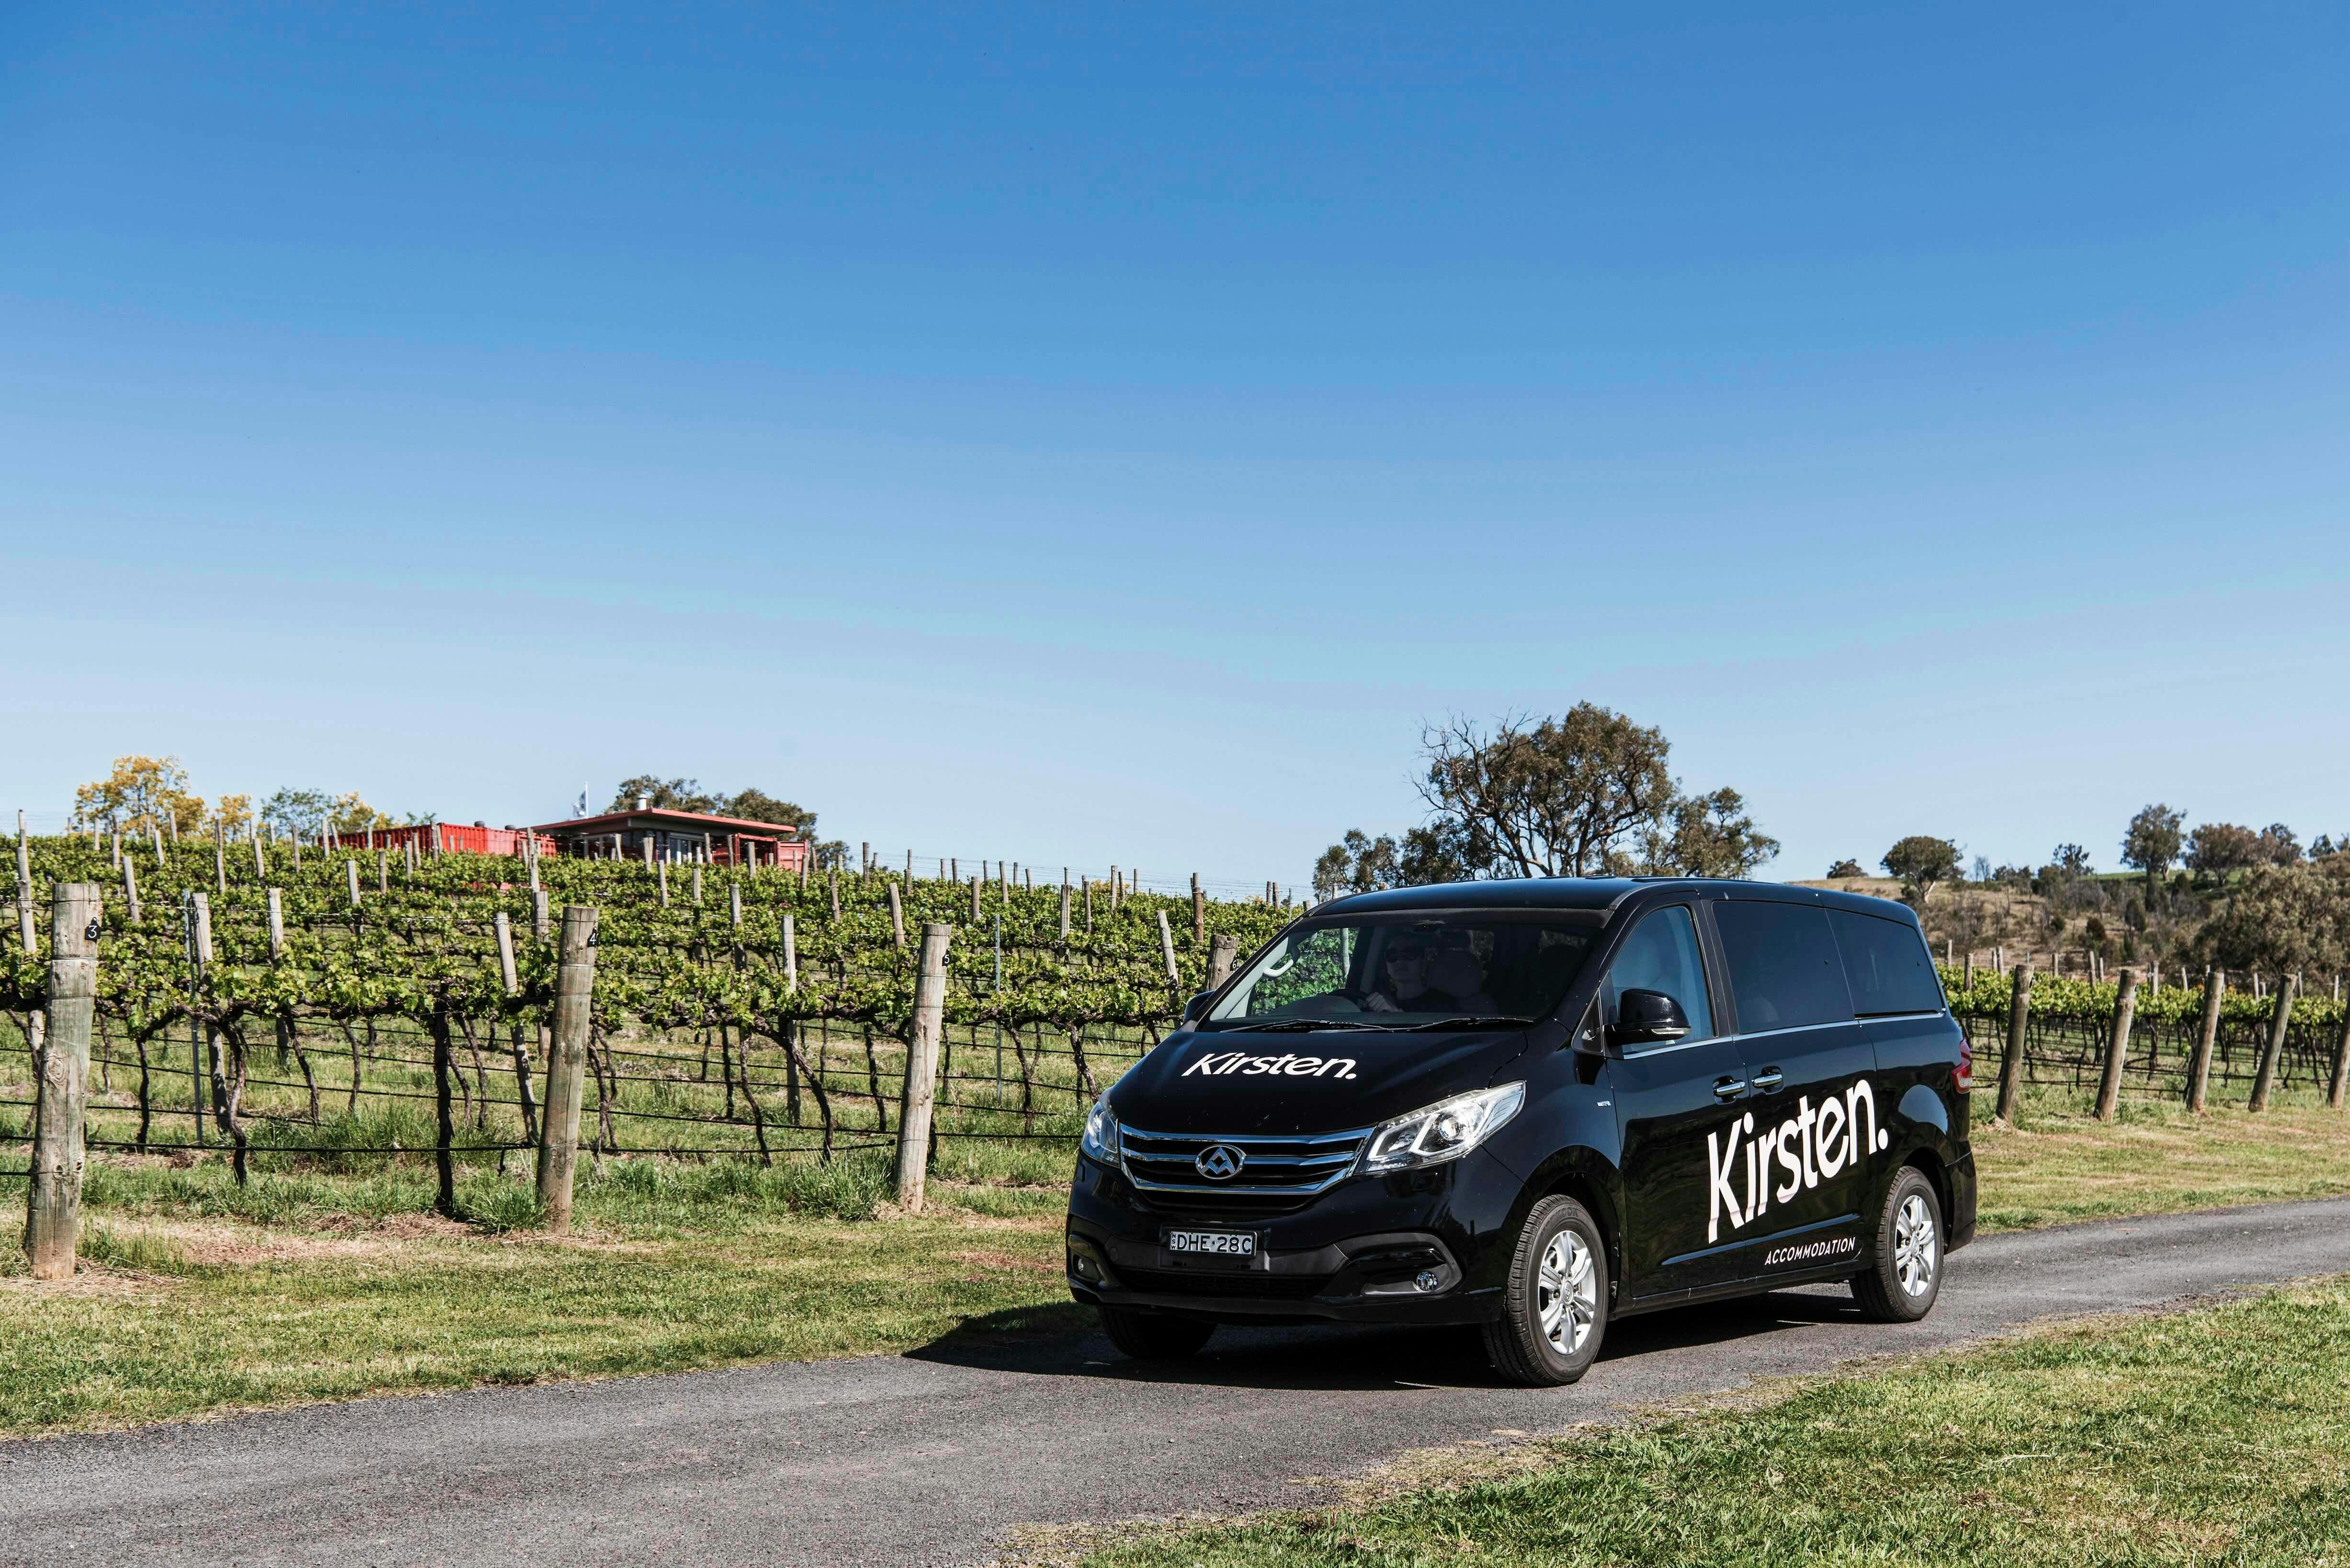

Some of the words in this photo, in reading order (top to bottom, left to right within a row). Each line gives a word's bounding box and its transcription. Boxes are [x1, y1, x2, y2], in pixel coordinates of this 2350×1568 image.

[88, 925, 97, 938] 3
[590, 933, 597, 945] 4
[944, 954, 950, 964] 5
[1232, 960, 1237, 969] 6
[1181, 1052, 1357, 1079] Kirsten.
[1707, 1079, 1888, 1244] Kirsten.
[1764, 1237, 1856, 1265] ACCOMMODATION
